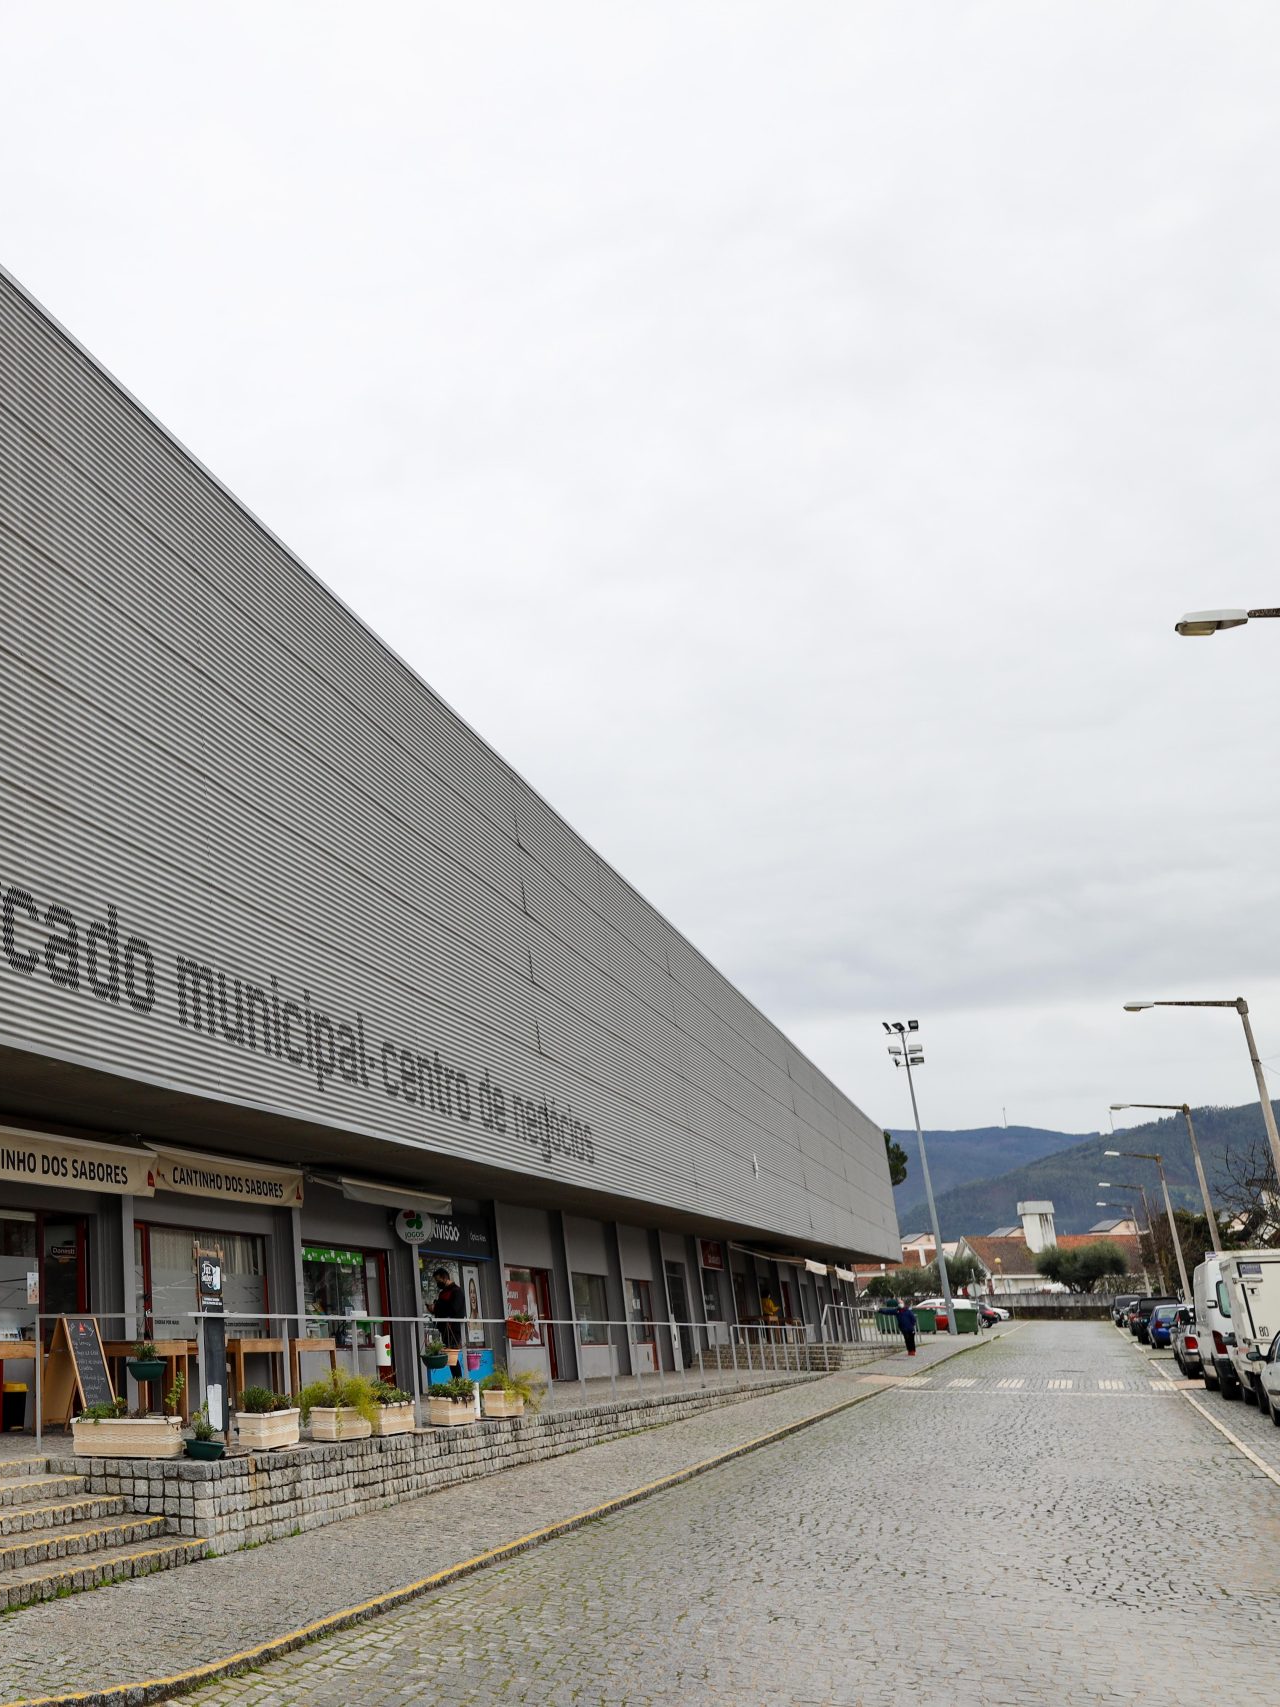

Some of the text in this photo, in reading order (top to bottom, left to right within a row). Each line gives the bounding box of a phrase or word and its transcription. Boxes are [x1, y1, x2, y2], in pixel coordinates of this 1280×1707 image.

[477, 1067, 507, 1134] de
[41, 1154, 68, 1178] DOS
[71, 1159, 129, 1185] SABORES
[172, 1166, 284, 1199] CANTINHO DOS SABORES
[1258, 1326, 1269, 1337] 80
